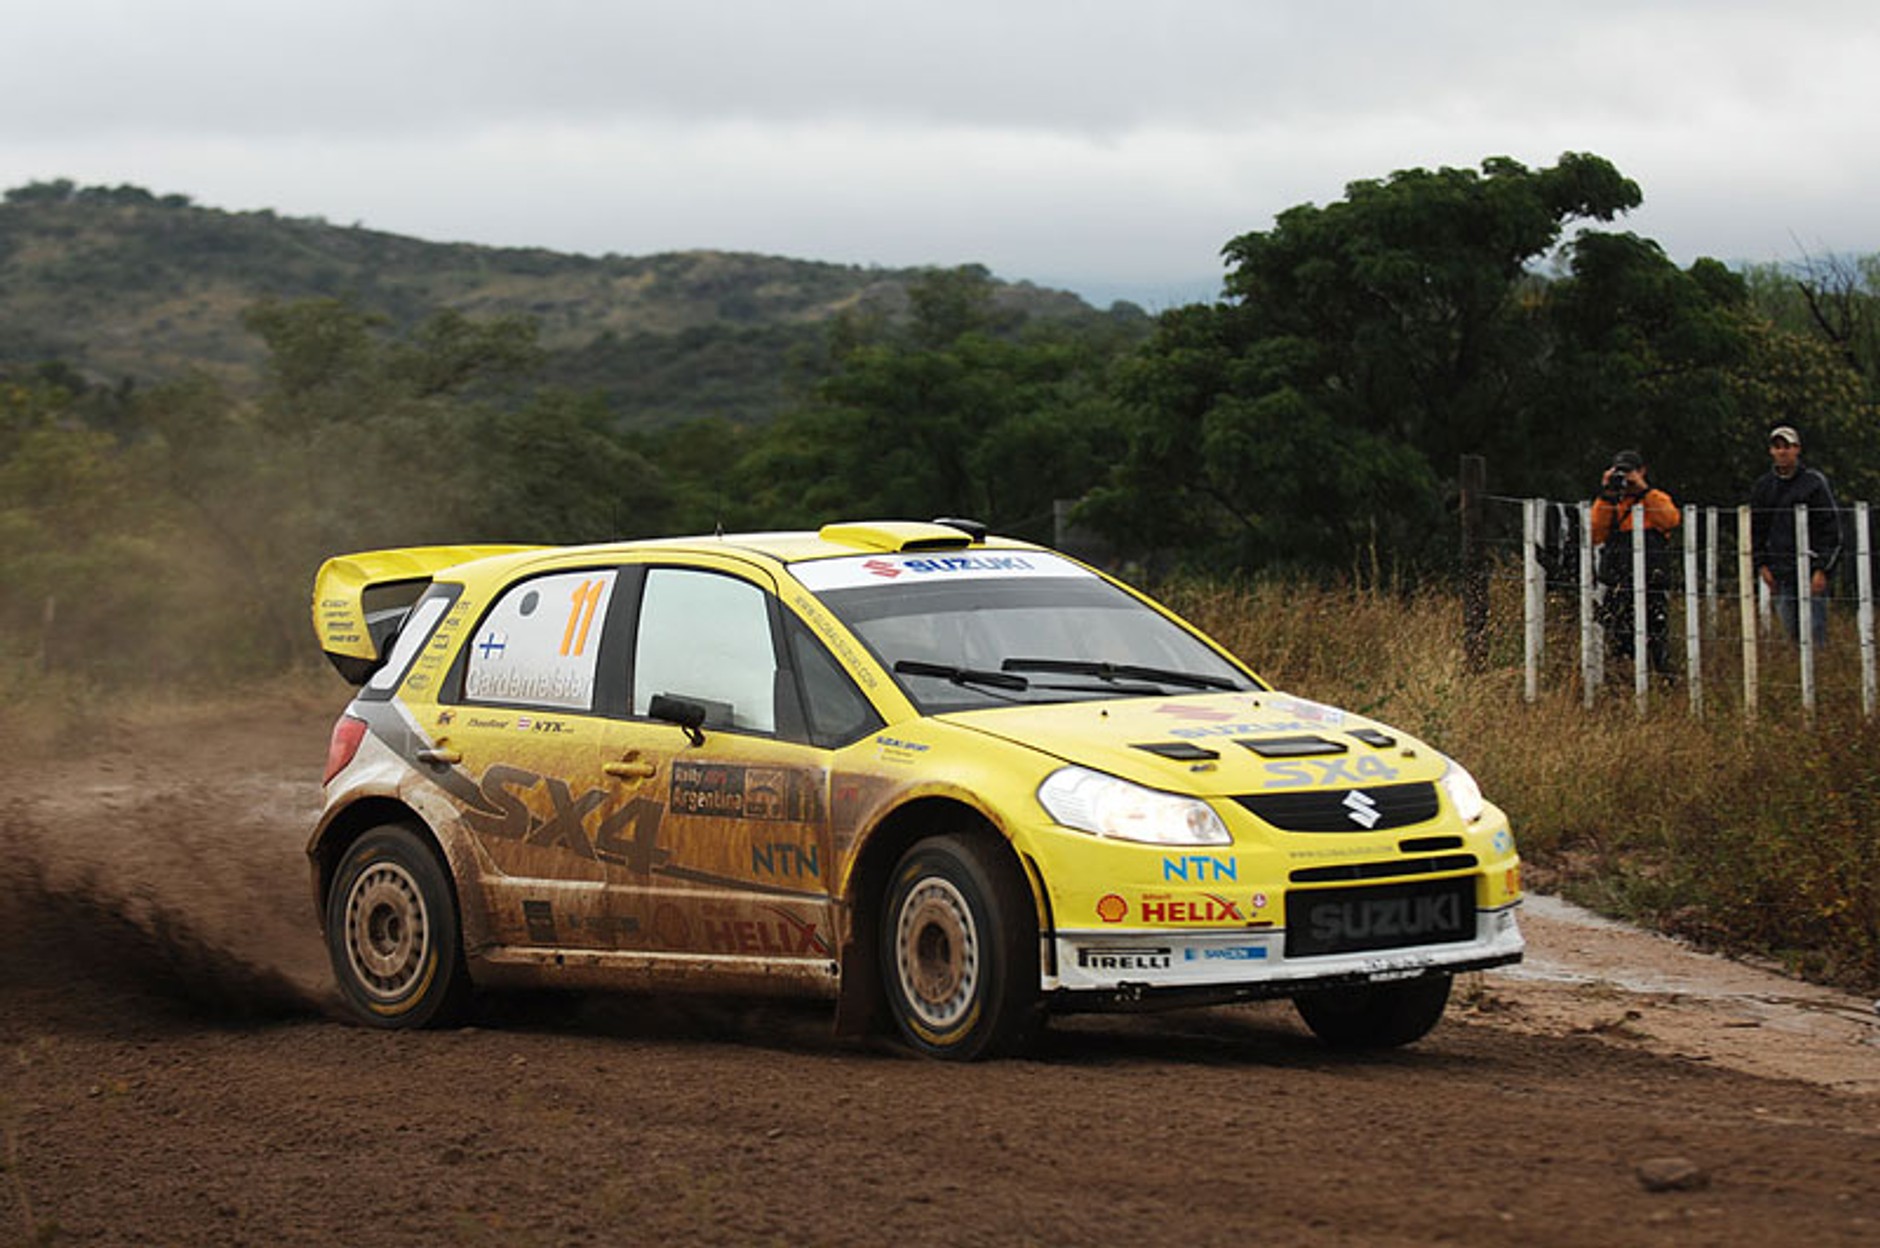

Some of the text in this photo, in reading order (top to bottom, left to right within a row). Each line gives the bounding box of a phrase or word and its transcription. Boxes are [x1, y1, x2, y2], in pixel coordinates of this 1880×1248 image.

[901, 556, 1036, 574] SUZUKI
[558, 579, 605, 657] 11
[1262, 755, 1399, 788] SX4
[462, 764, 673, 876] SX4
[751, 843, 821, 879] NTN
[1162, 856, 1238, 882] NTN
[1141, 898, 1244, 923] HELIX
[1310, 893, 1461, 940] SUZUKI
[703, 918, 829, 955] HELIX
[1076, 946, 1172, 969] PIRELLI
